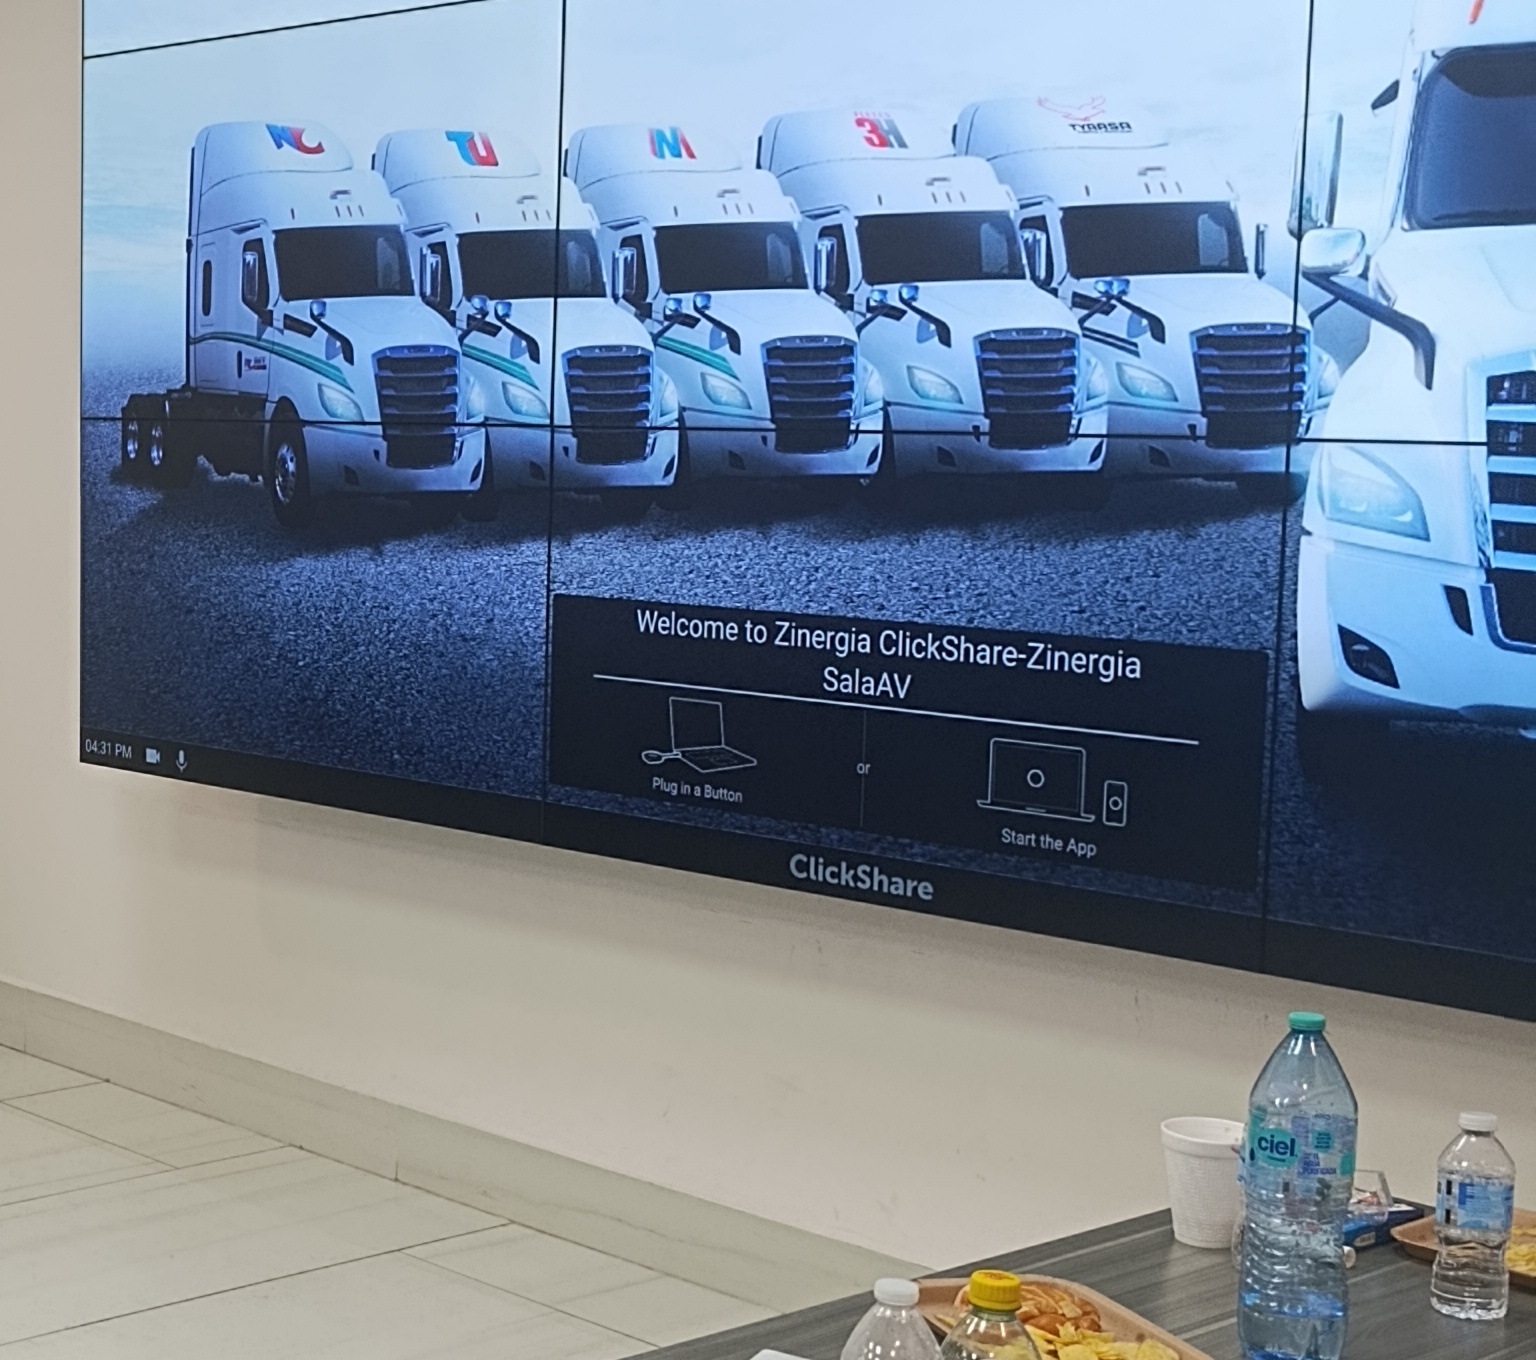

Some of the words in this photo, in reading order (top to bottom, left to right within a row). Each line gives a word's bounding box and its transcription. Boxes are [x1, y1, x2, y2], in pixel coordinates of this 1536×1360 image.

[636, 608, 739, 641] Welcome
[744, 619, 768, 644] to
[774, 620, 872, 658] Zinergia
[878, 629, 1142, 683] ClickShare-Zinergia
[822, 665, 912, 700] SalaAV
[115, 743, 133, 759] PM
[856, 762, 871, 775] or
[651, 775, 679, 796] Plug
[679, 780, 692, 795] in
[693, 785, 701, 797] a
[703, 783, 743, 803] Button
[1000, 827, 1038, 846] Start
[1039, 832, 1064, 851] the
[1065, 837, 1097, 858] App
[788, 852, 935, 901] ClickShare
[1257, 1133, 1295, 1157] ciel
